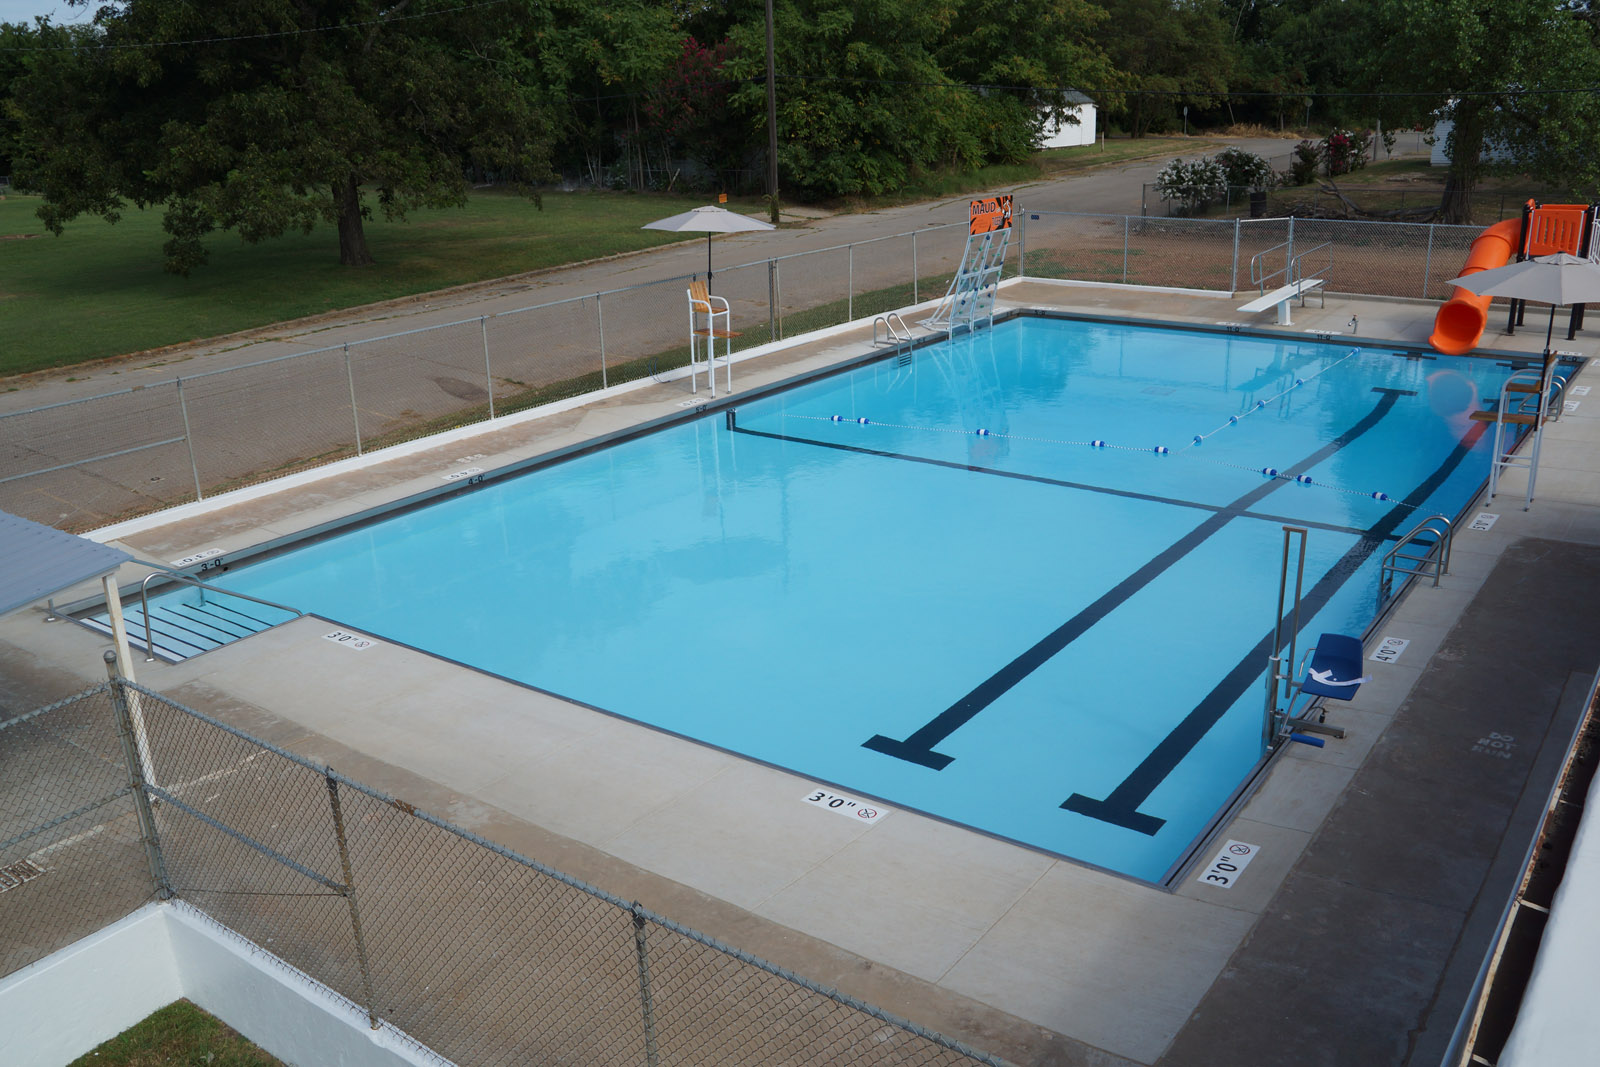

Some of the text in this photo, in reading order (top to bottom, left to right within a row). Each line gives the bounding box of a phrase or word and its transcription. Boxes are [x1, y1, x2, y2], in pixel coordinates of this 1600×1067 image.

[972, 202, 996, 216] MAUD
[808, 792, 856, 808] 3'0"
[1206, 856, 1238, 885] 3'0"
